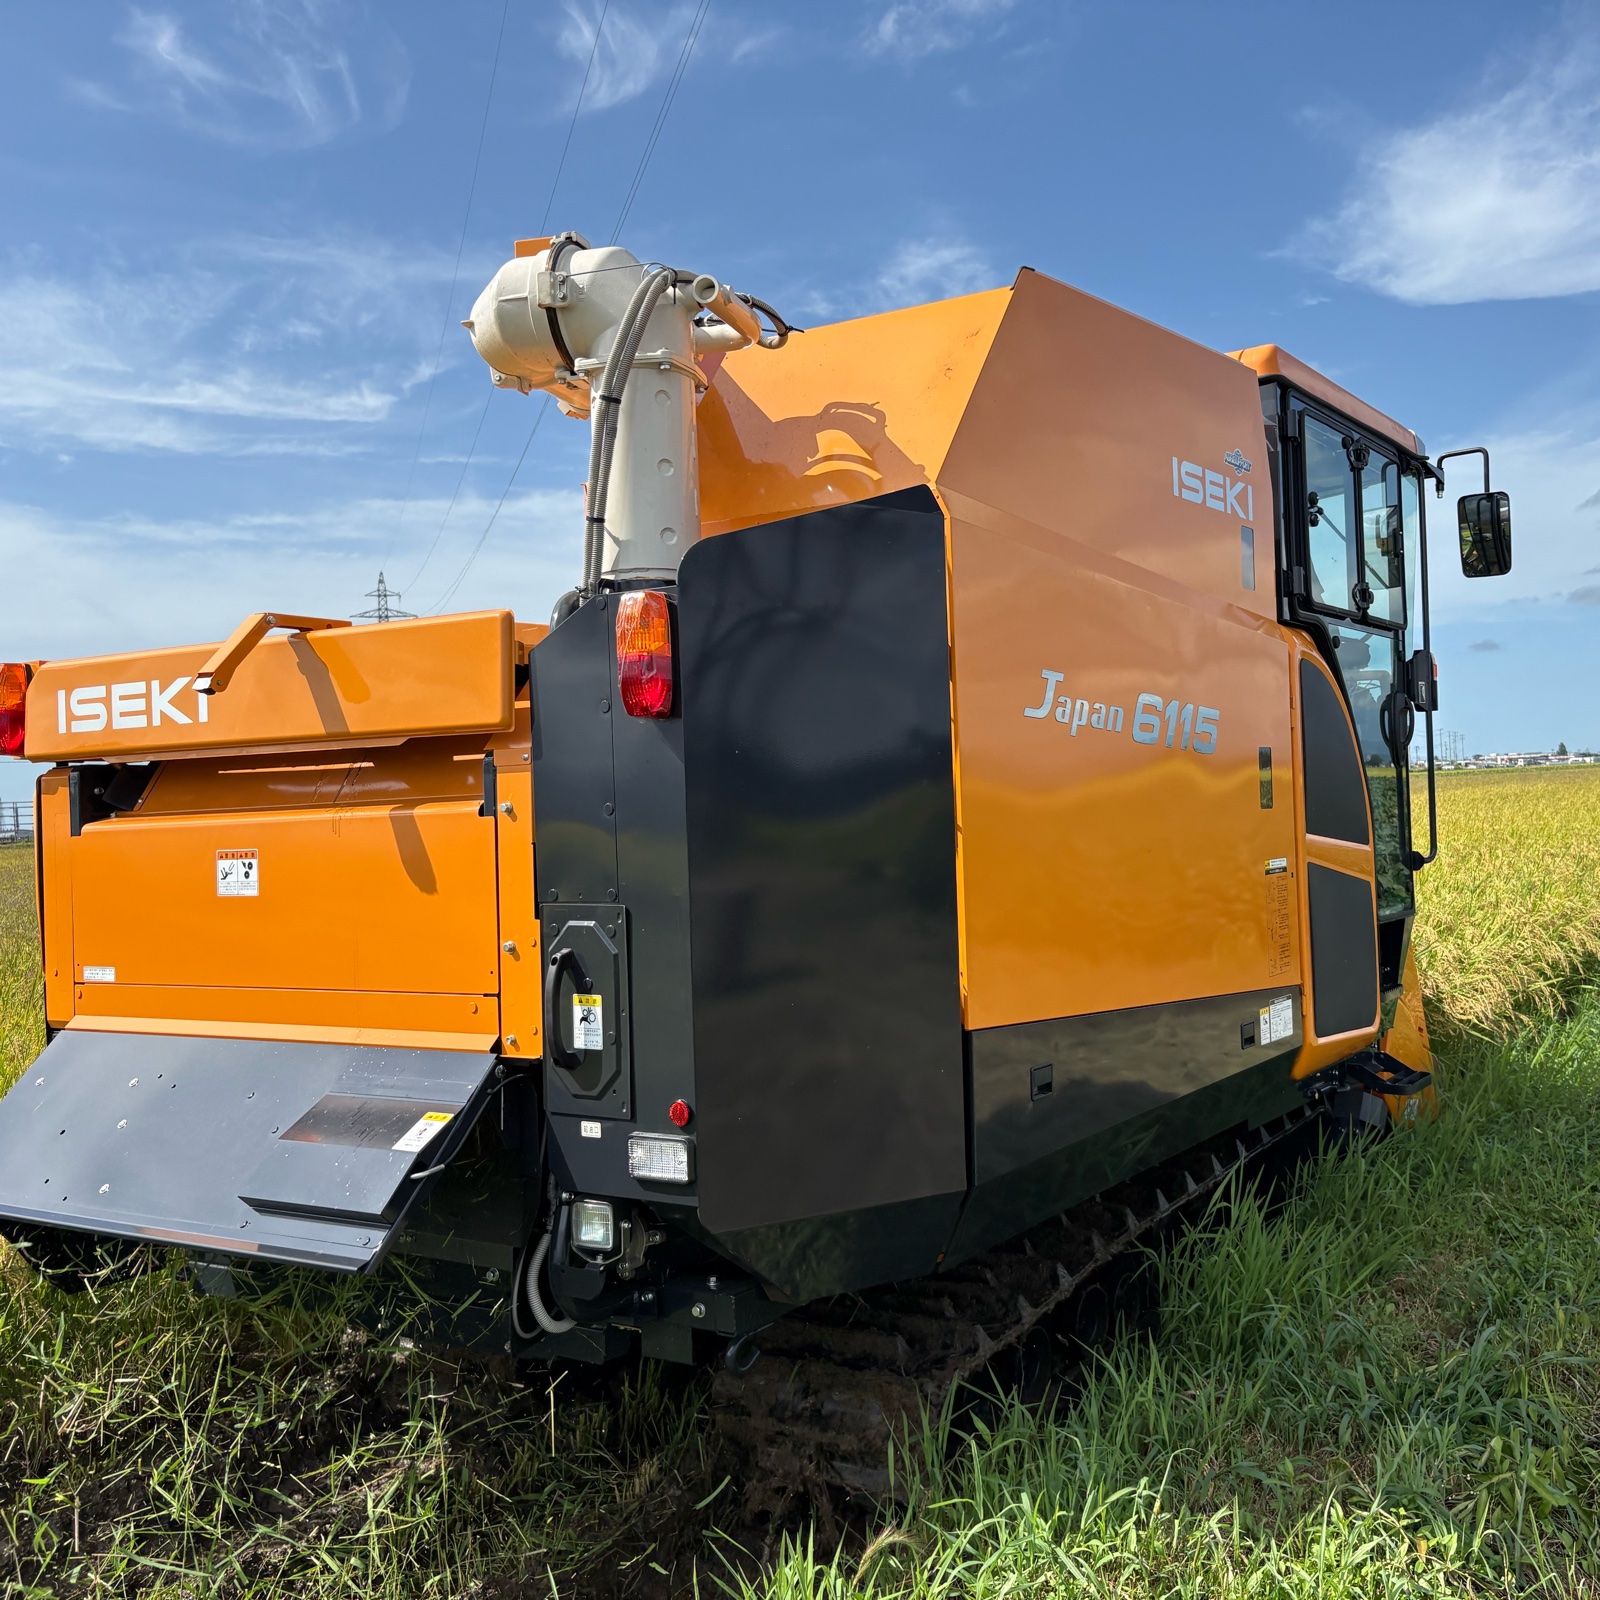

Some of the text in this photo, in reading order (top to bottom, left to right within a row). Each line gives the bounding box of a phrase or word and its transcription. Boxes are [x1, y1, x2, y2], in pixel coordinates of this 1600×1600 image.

[1172, 456, 1253, 521] ISEKI
[57, 676, 209, 734] ISEKI
[1023, 668, 1221, 755] Japan 6115
